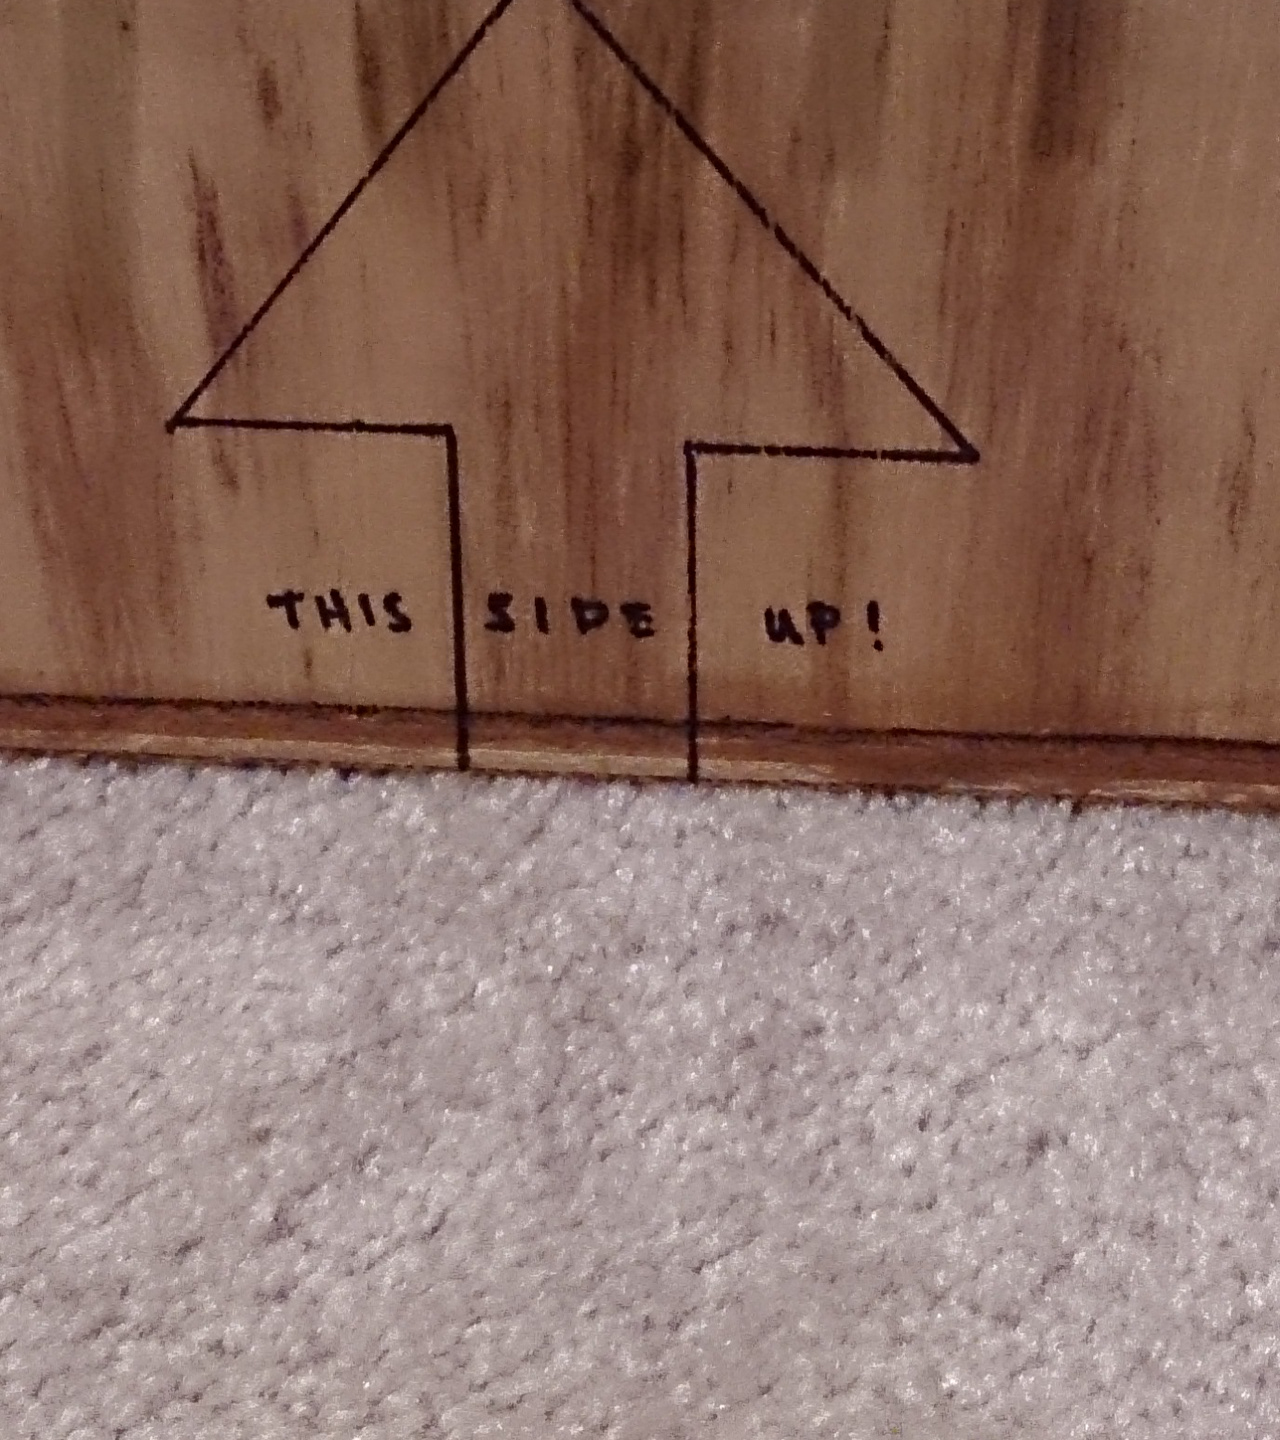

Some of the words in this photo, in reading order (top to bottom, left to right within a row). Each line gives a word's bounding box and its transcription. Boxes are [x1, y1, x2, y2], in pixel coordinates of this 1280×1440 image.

[267, 589, 411, 633] THIS
[484, 591, 655, 636] SIDE
[764, 600, 883, 651] UP!
